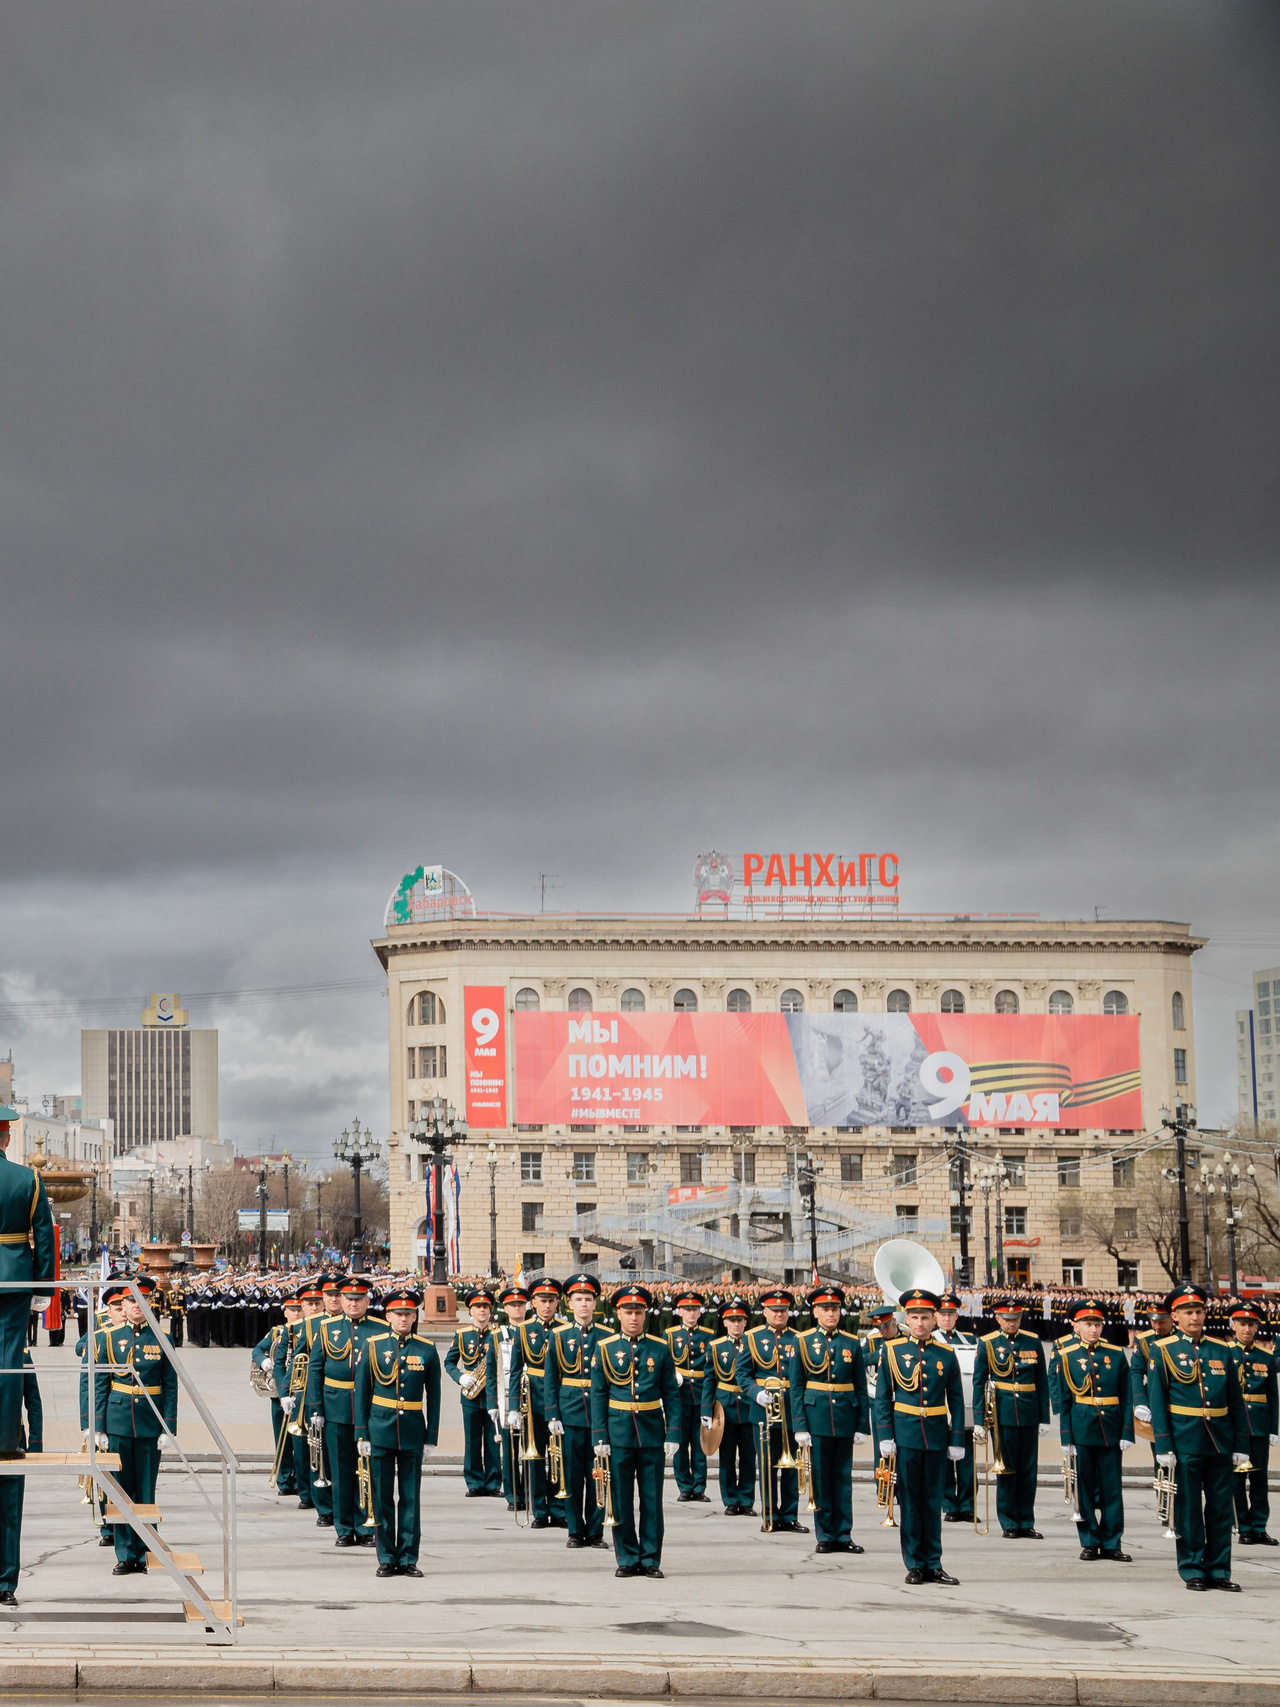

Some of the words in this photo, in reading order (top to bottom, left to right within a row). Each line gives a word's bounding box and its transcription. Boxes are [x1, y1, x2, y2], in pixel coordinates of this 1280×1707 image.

[743, 852, 900, 888] РАНХиГС
[407, 894, 473, 911] Хабаровск
[471, 1007, 500, 1046] 9
[568, 1019, 619, 1044] МЫ
[474, 1047, 497, 1057] МАЯ
[470, 1070, 483, 1078] МЫ
[568, 1054, 708, 1079] ПОМНИМ!
[470, 1079, 504, 1087] ПОМНИМ!
[920, 1051, 972, 1120] 9
[968, 1092, 1060, 1122] МАЯ
[571, 1087, 663, 1102] 1941-1945
[571, 1108, 641, 1119] #МЫВМЕСТЕ
